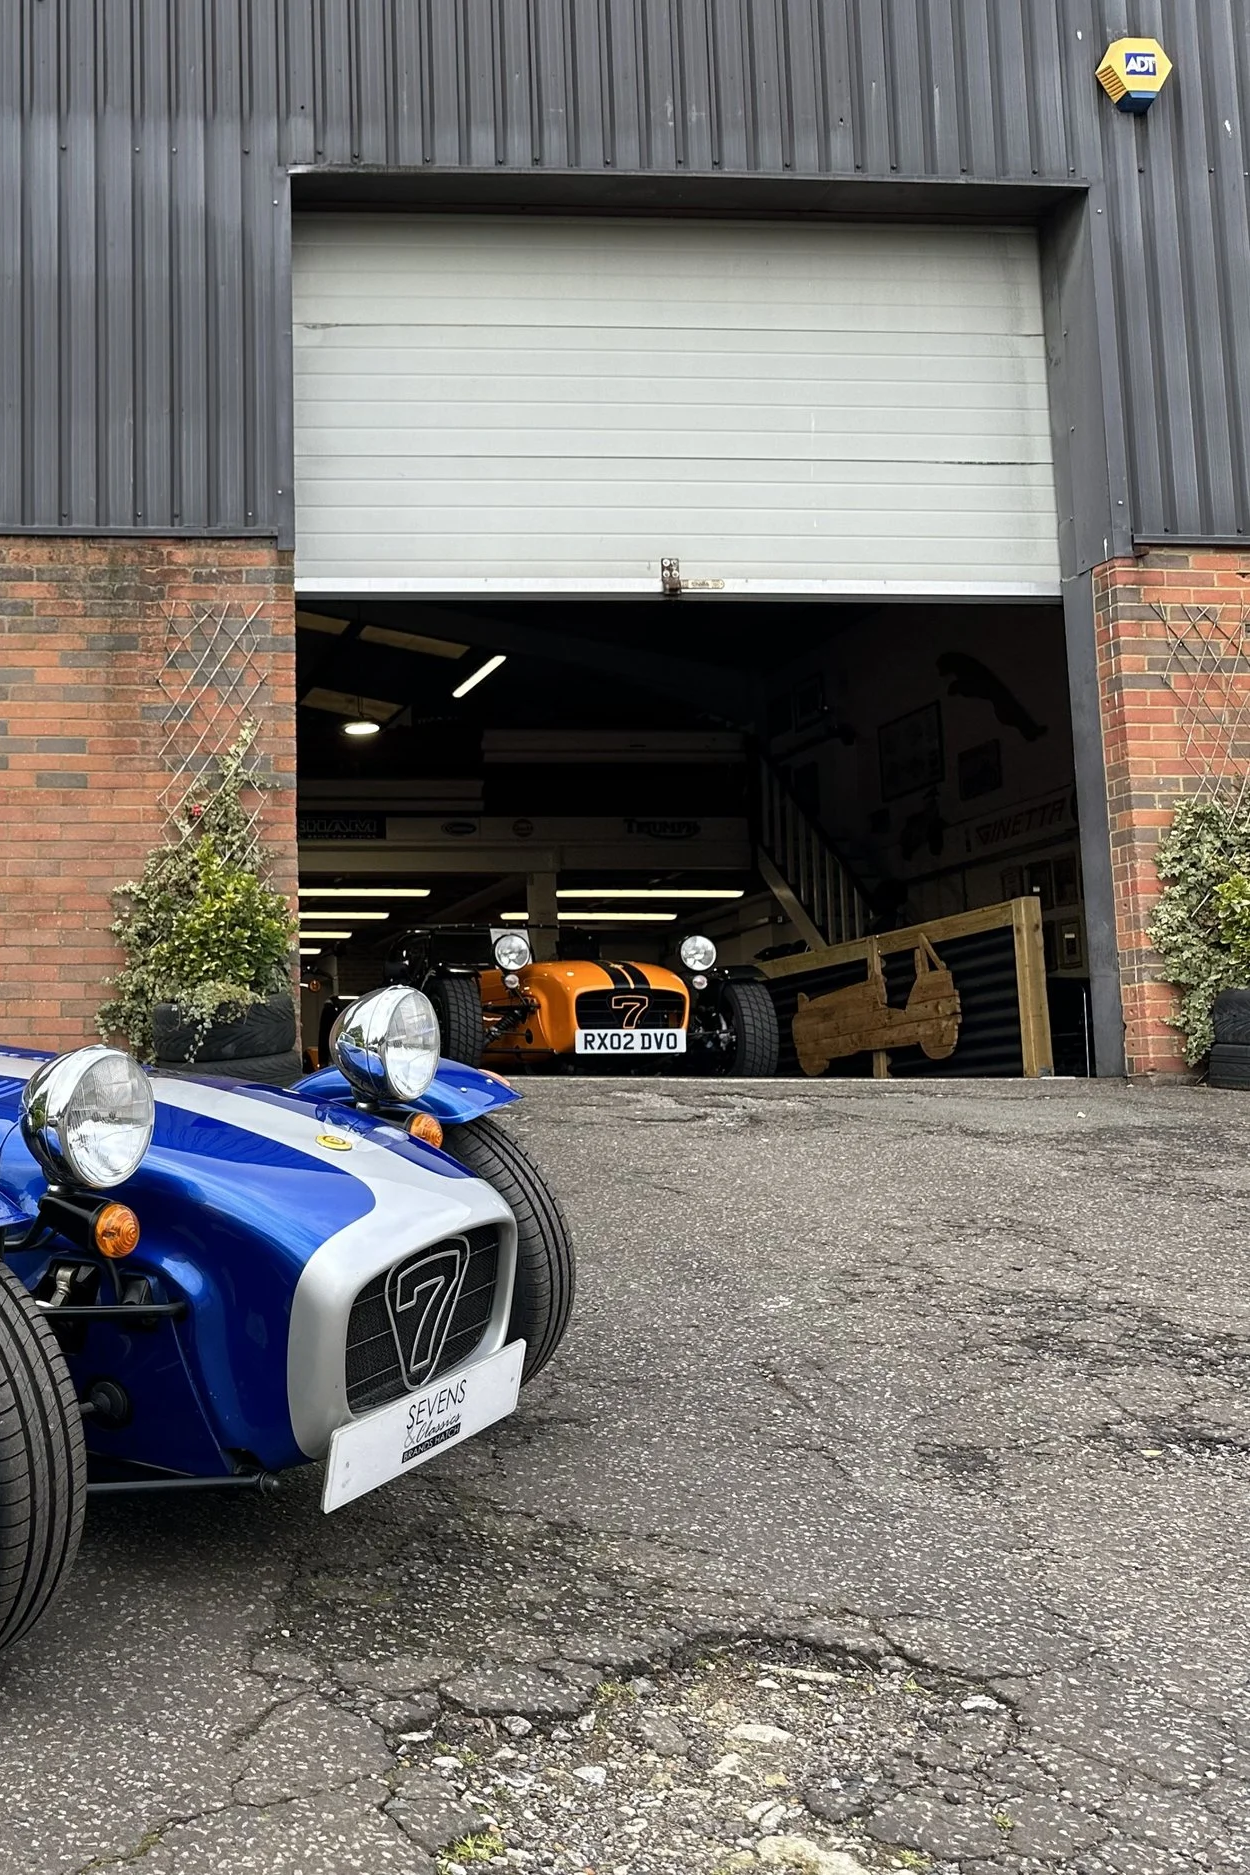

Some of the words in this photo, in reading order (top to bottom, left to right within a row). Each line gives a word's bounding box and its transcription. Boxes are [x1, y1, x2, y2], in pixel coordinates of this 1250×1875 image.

[1126, 56, 1156, 73] ADT
[611, 995, 649, 1029] 7
[583, 1033, 634, 1050] RX02
[640, 1033, 678, 1050] DVO
[396, 1249, 460, 1373] 7
[406, 1379, 467, 1430] SEVENS
[403, 1440, 433, 1462] BRANDS
[434, 1424, 461, 1446] HATCH
